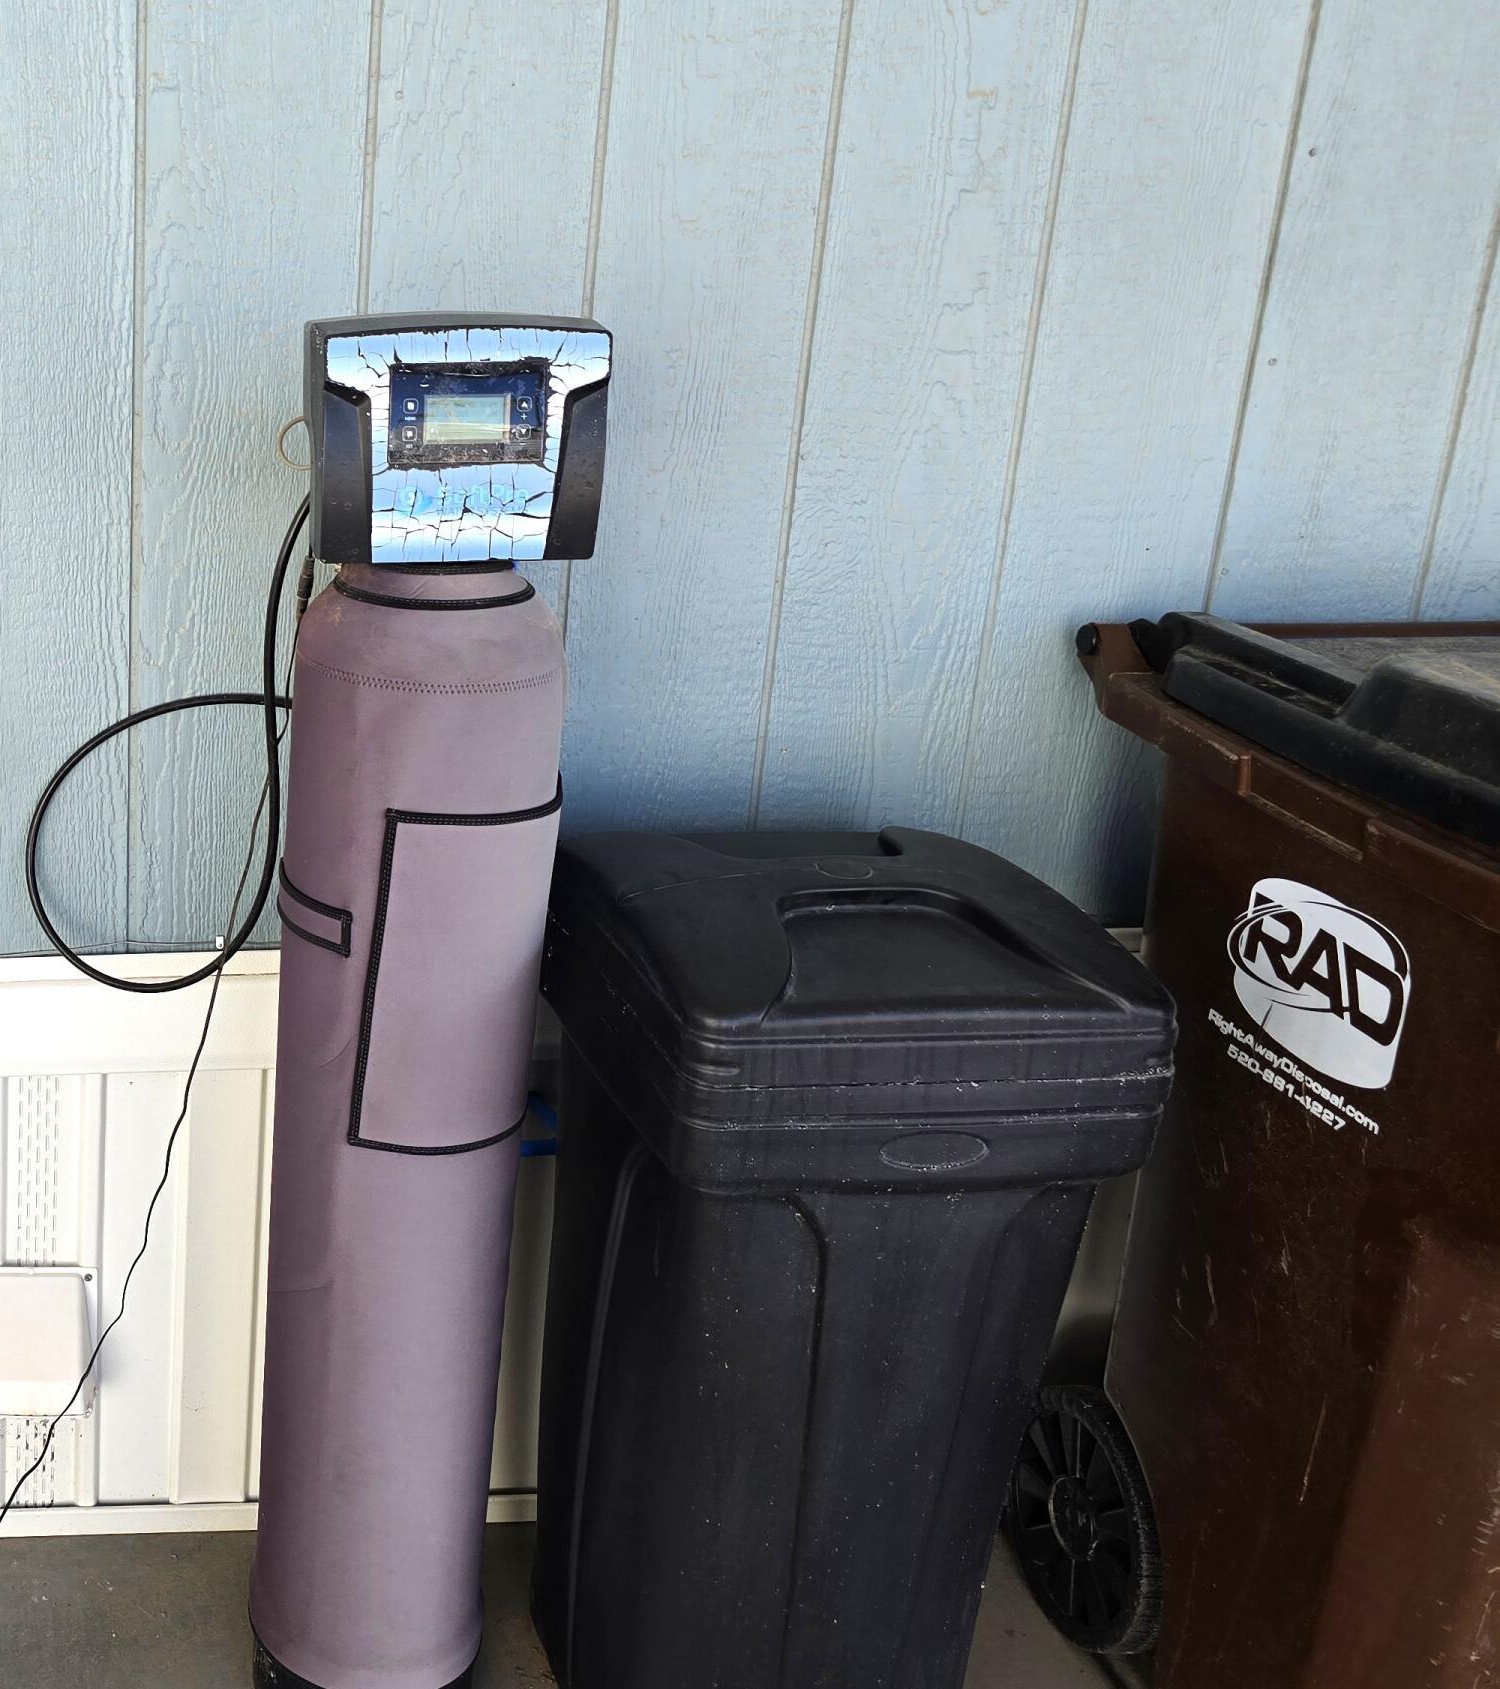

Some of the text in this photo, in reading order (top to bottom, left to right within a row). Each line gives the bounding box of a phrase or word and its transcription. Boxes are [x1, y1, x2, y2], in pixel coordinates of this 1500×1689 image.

[1243, 892, 1405, 1047] RAD
[1207, 1008, 1380, 1135] RightAwayDisposal.com
[1227, 1043, 1347, 1131] 520-881-4227
